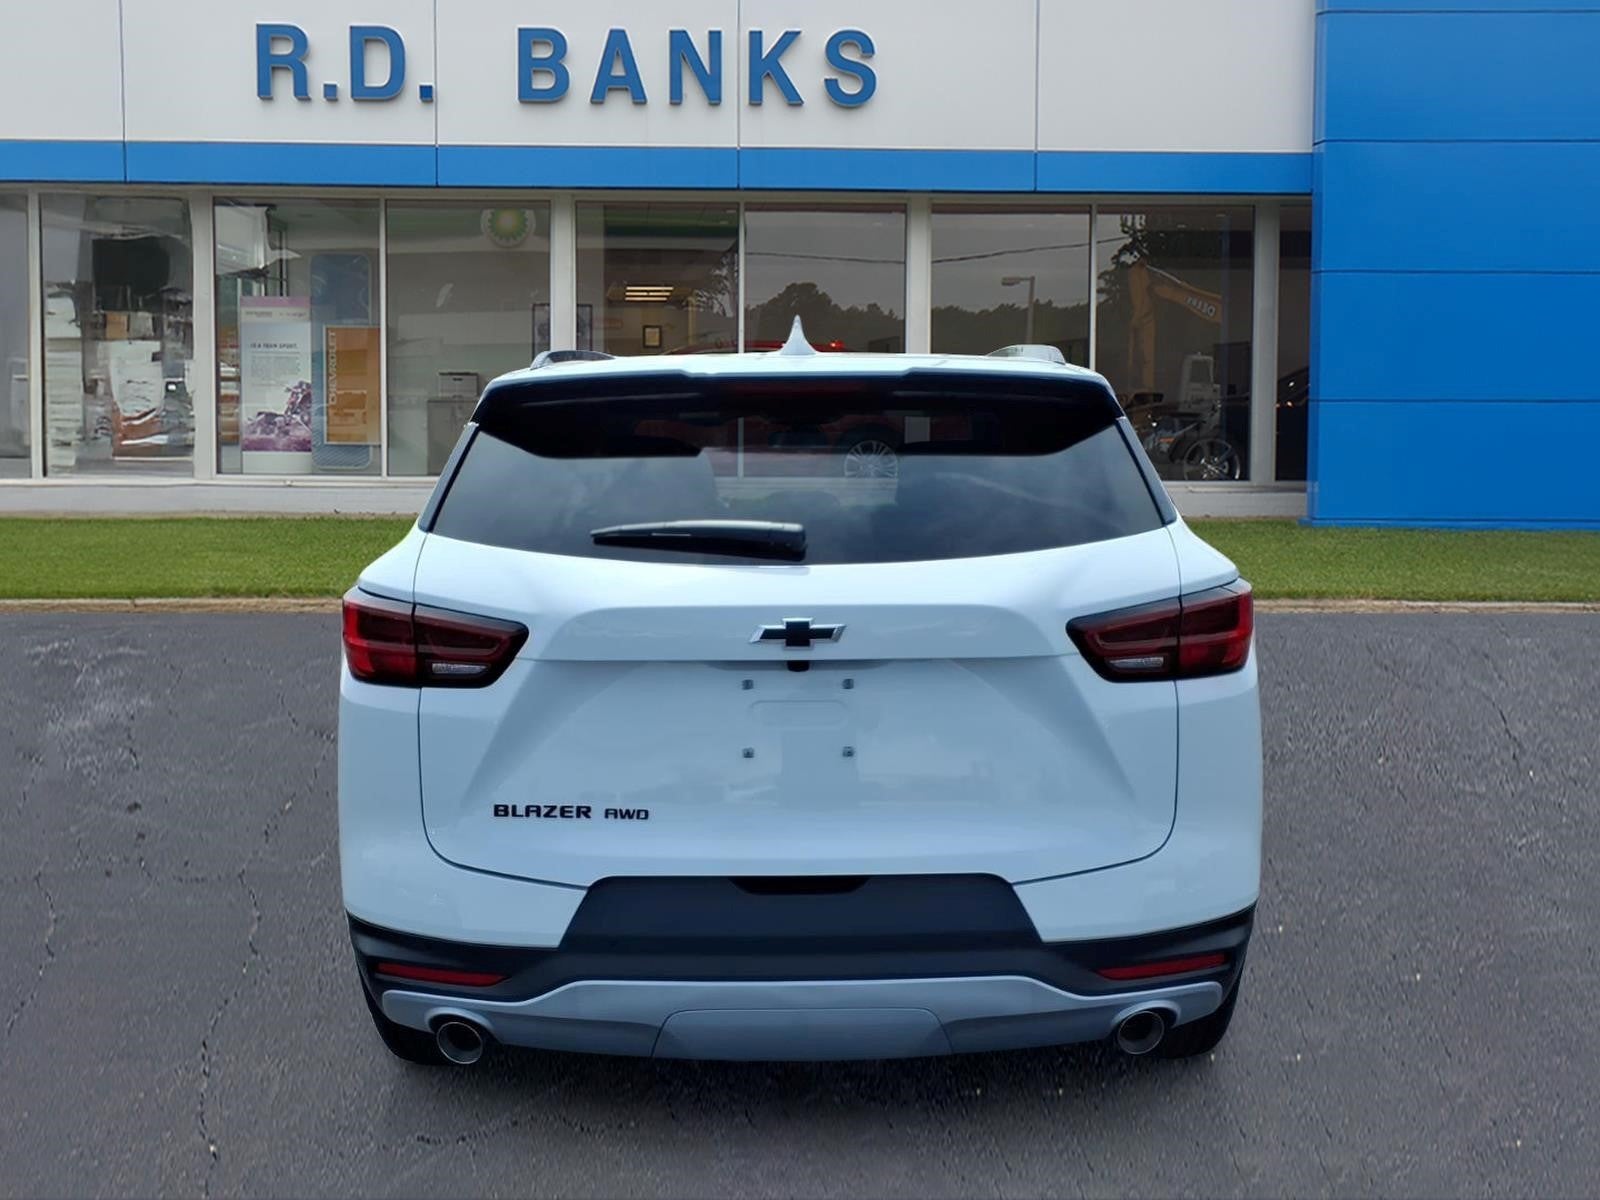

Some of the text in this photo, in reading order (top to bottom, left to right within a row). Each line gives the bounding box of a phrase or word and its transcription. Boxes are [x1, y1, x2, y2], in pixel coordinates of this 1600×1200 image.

[256, 23, 878, 107] R.D. BANKS
[327, 328, 337, 405] CHEVROLET
[493, 803, 649, 820] BLAZER AWD
